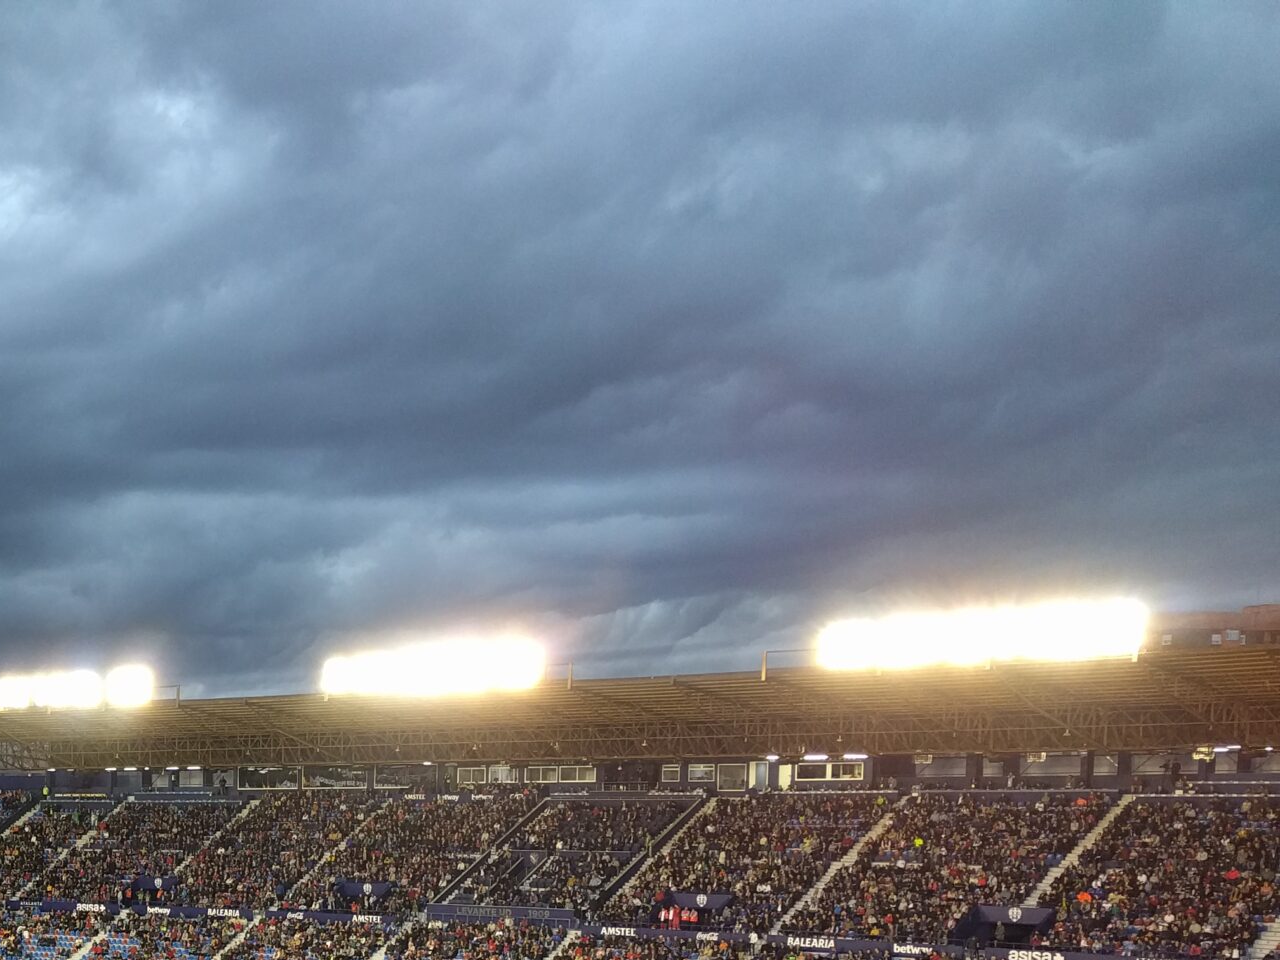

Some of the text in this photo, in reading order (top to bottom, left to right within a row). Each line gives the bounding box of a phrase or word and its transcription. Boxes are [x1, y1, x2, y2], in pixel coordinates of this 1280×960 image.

[147, 906, 170, 916] betway
[456, 906, 550, 918] LEVANTE UD 1909
[352, 915, 382, 924] AMSTEL
[600, 926, 636, 937] AMSTEL
[893, 943, 932, 956] betway
